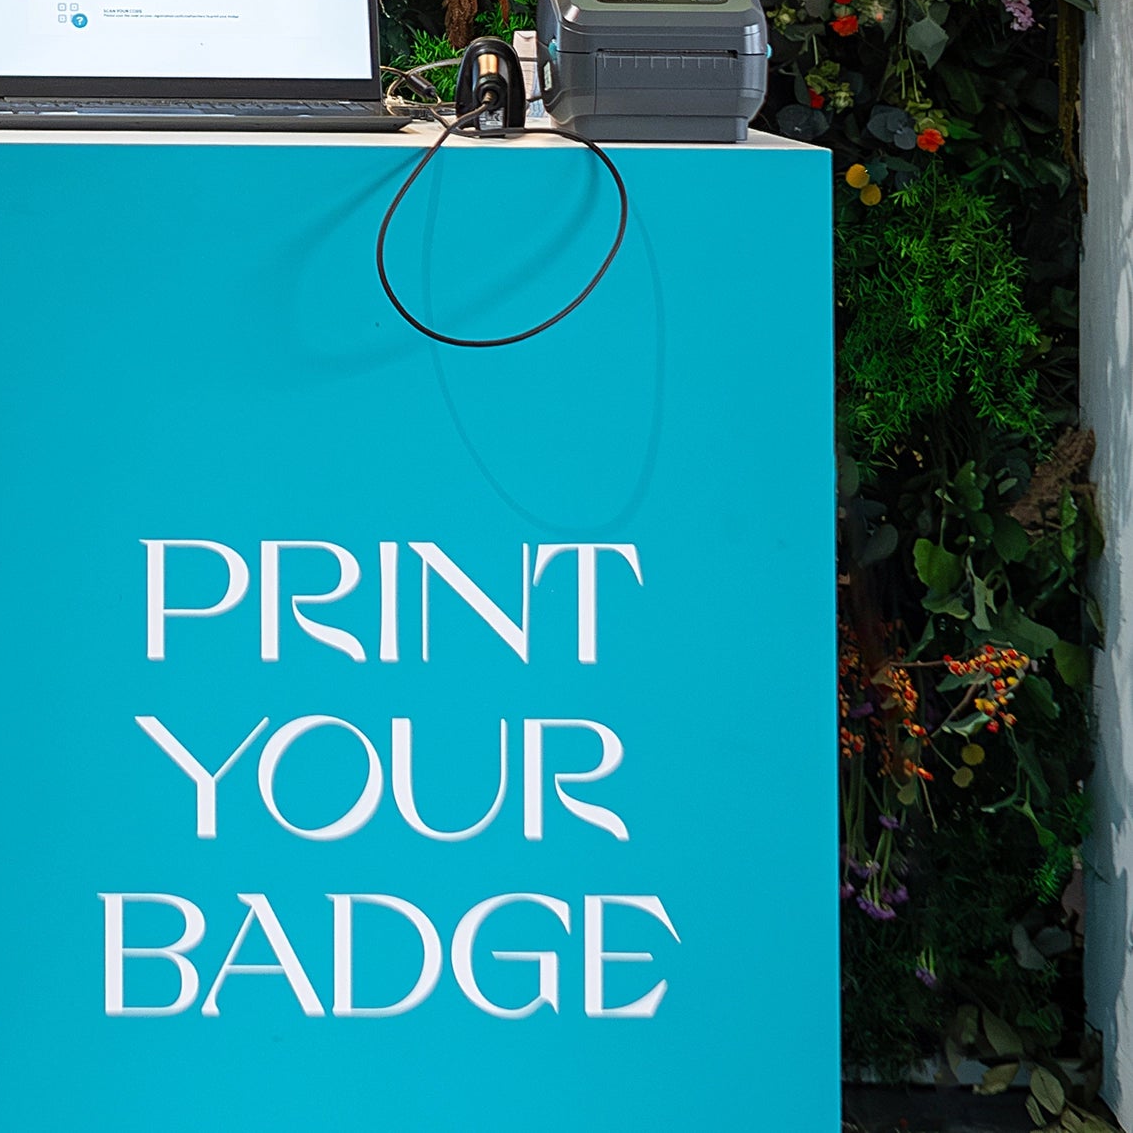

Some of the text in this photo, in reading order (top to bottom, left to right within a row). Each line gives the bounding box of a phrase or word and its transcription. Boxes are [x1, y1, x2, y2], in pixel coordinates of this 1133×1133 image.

[138, 539, 644, 664] PRINT
[134, 714, 630, 842] YOUR
[96, 892, 681, 1019] BADGE
